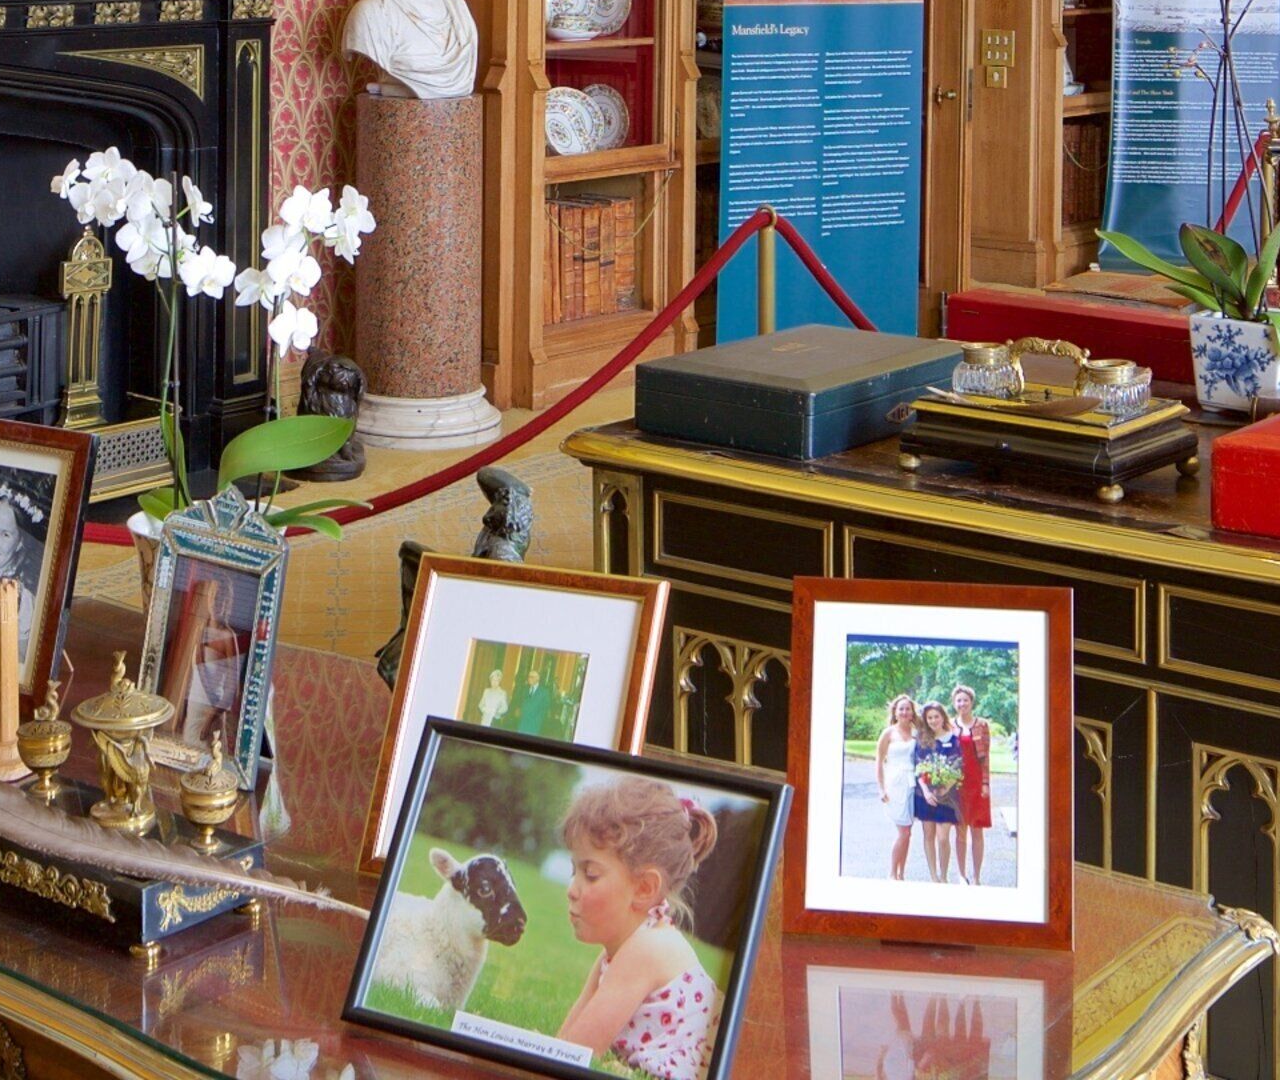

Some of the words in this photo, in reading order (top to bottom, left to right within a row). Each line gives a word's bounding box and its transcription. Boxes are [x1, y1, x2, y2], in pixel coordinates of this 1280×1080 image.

[732, 23, 778, 36] Mansfield's
[780, 23, 809, 37] Legacy
[460, 1022, 471, 1032] The
[490, 1031, 515, 1044] Louisa
[517, 1039, 545, 1053] Murray
